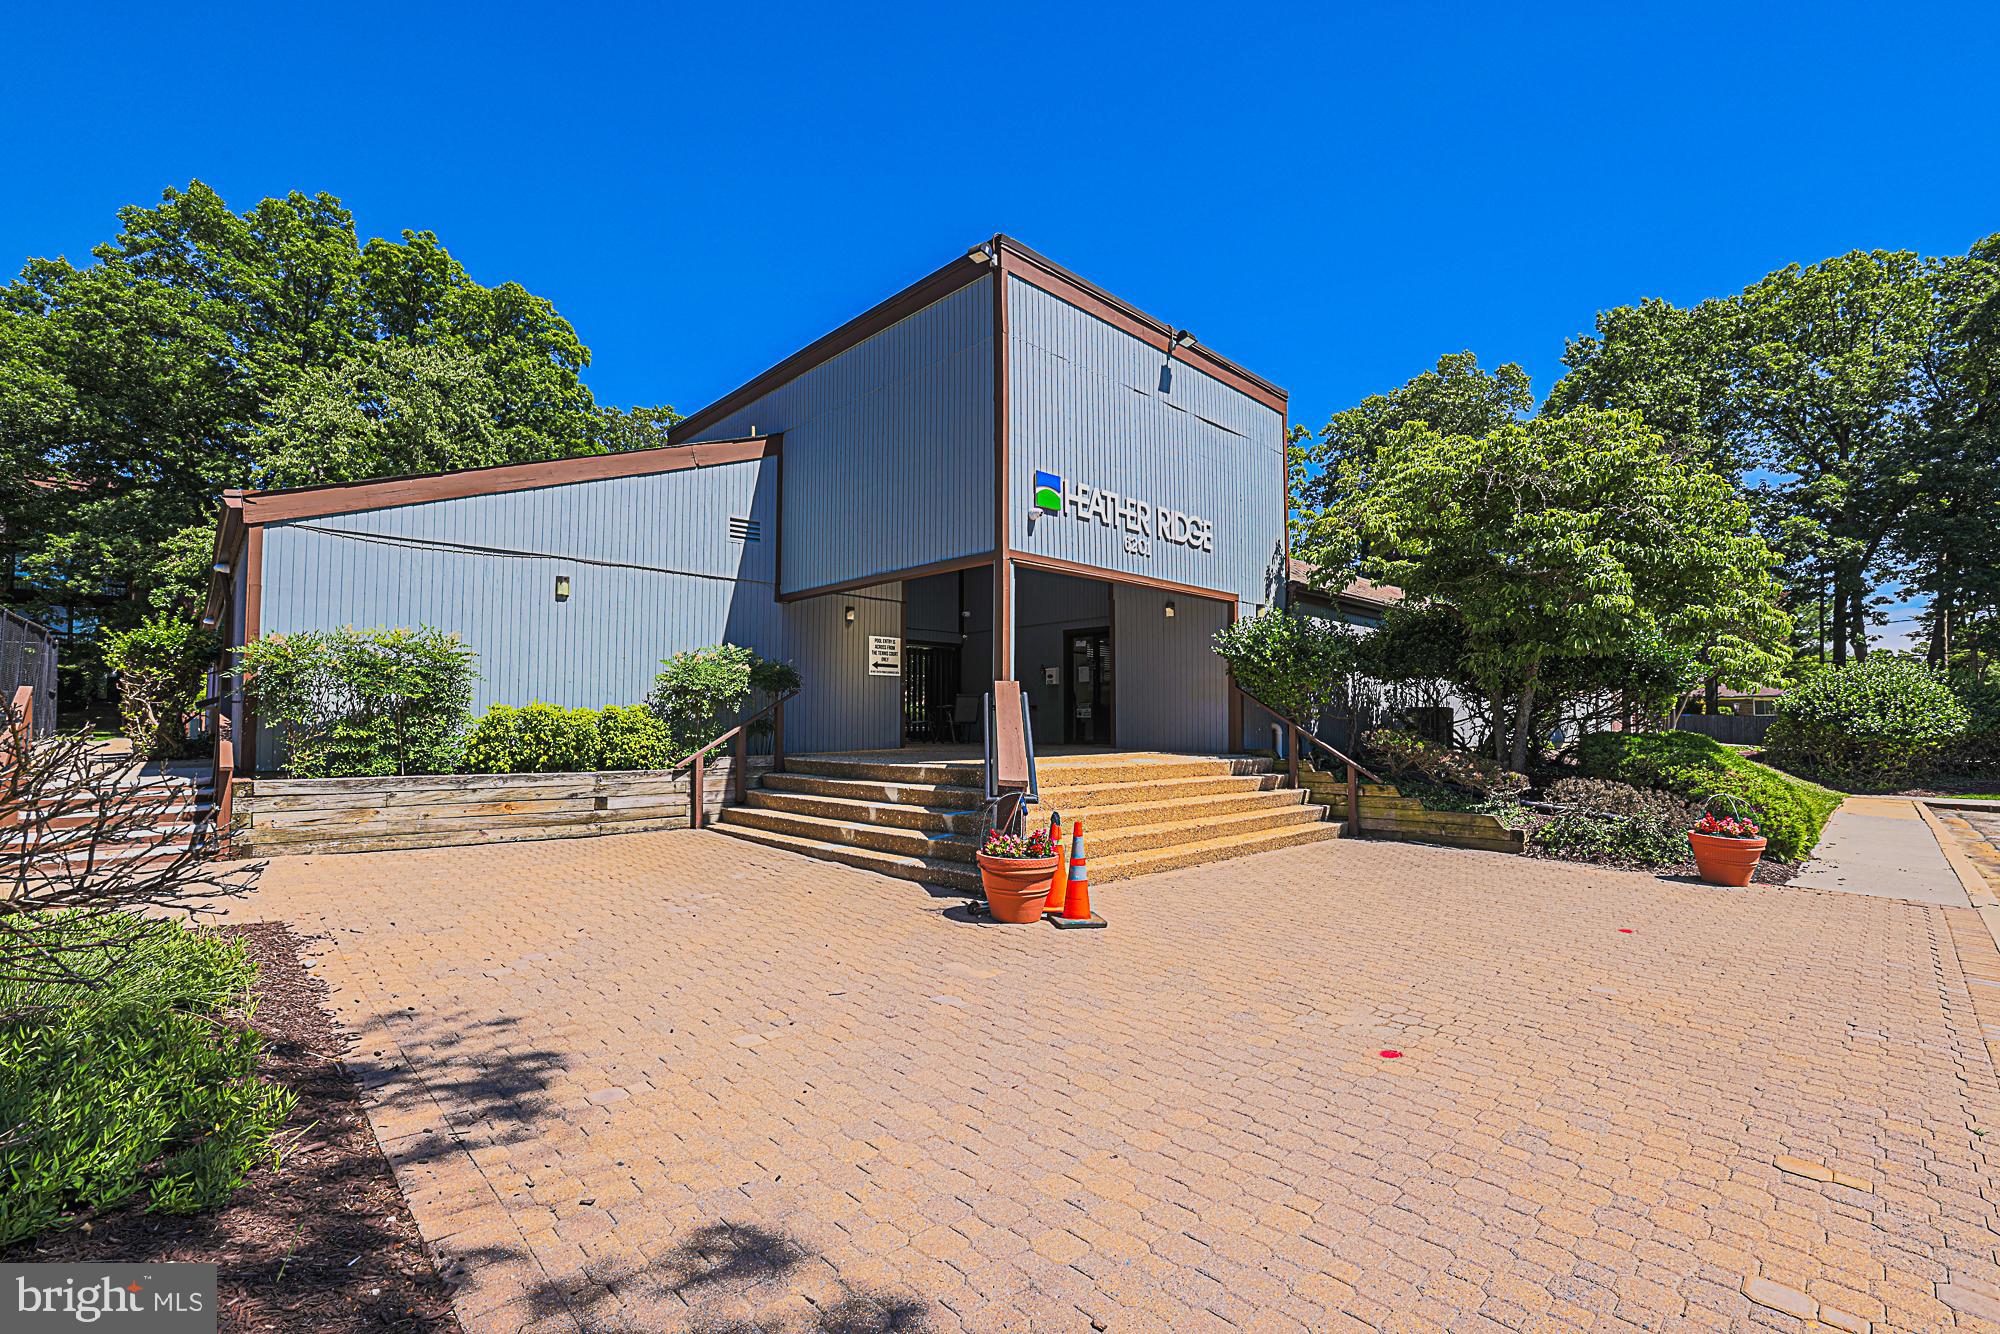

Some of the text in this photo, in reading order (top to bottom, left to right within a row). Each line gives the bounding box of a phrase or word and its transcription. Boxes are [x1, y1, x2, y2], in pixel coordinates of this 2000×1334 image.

[1063, 479, 1213, 552] HEATHER RIDGE
[1124, 536, 1151, 557] 6201
